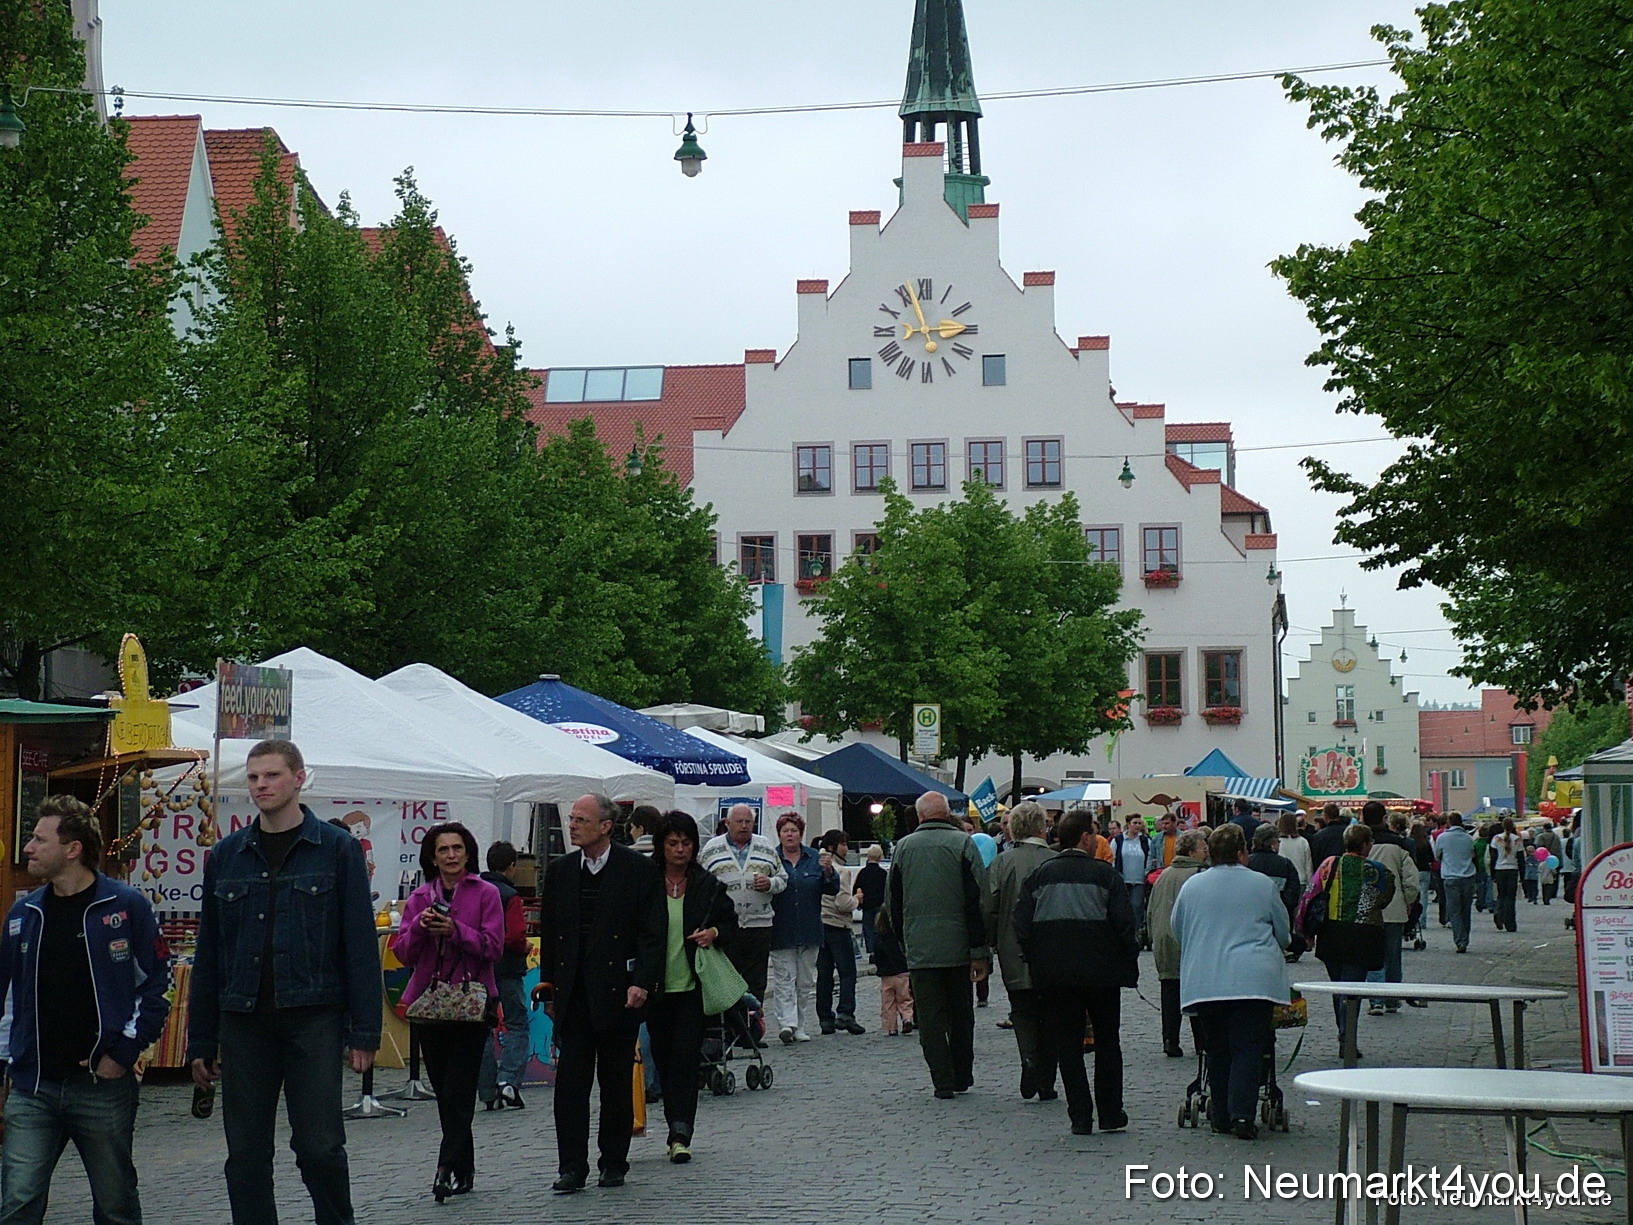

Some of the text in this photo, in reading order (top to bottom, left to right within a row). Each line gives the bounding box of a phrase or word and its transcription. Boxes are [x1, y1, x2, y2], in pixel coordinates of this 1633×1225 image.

[917, 278, 932, 300] XII
[878, 303, 901, 319] X
[674, 760, 707, 775] FÖRSTINA
